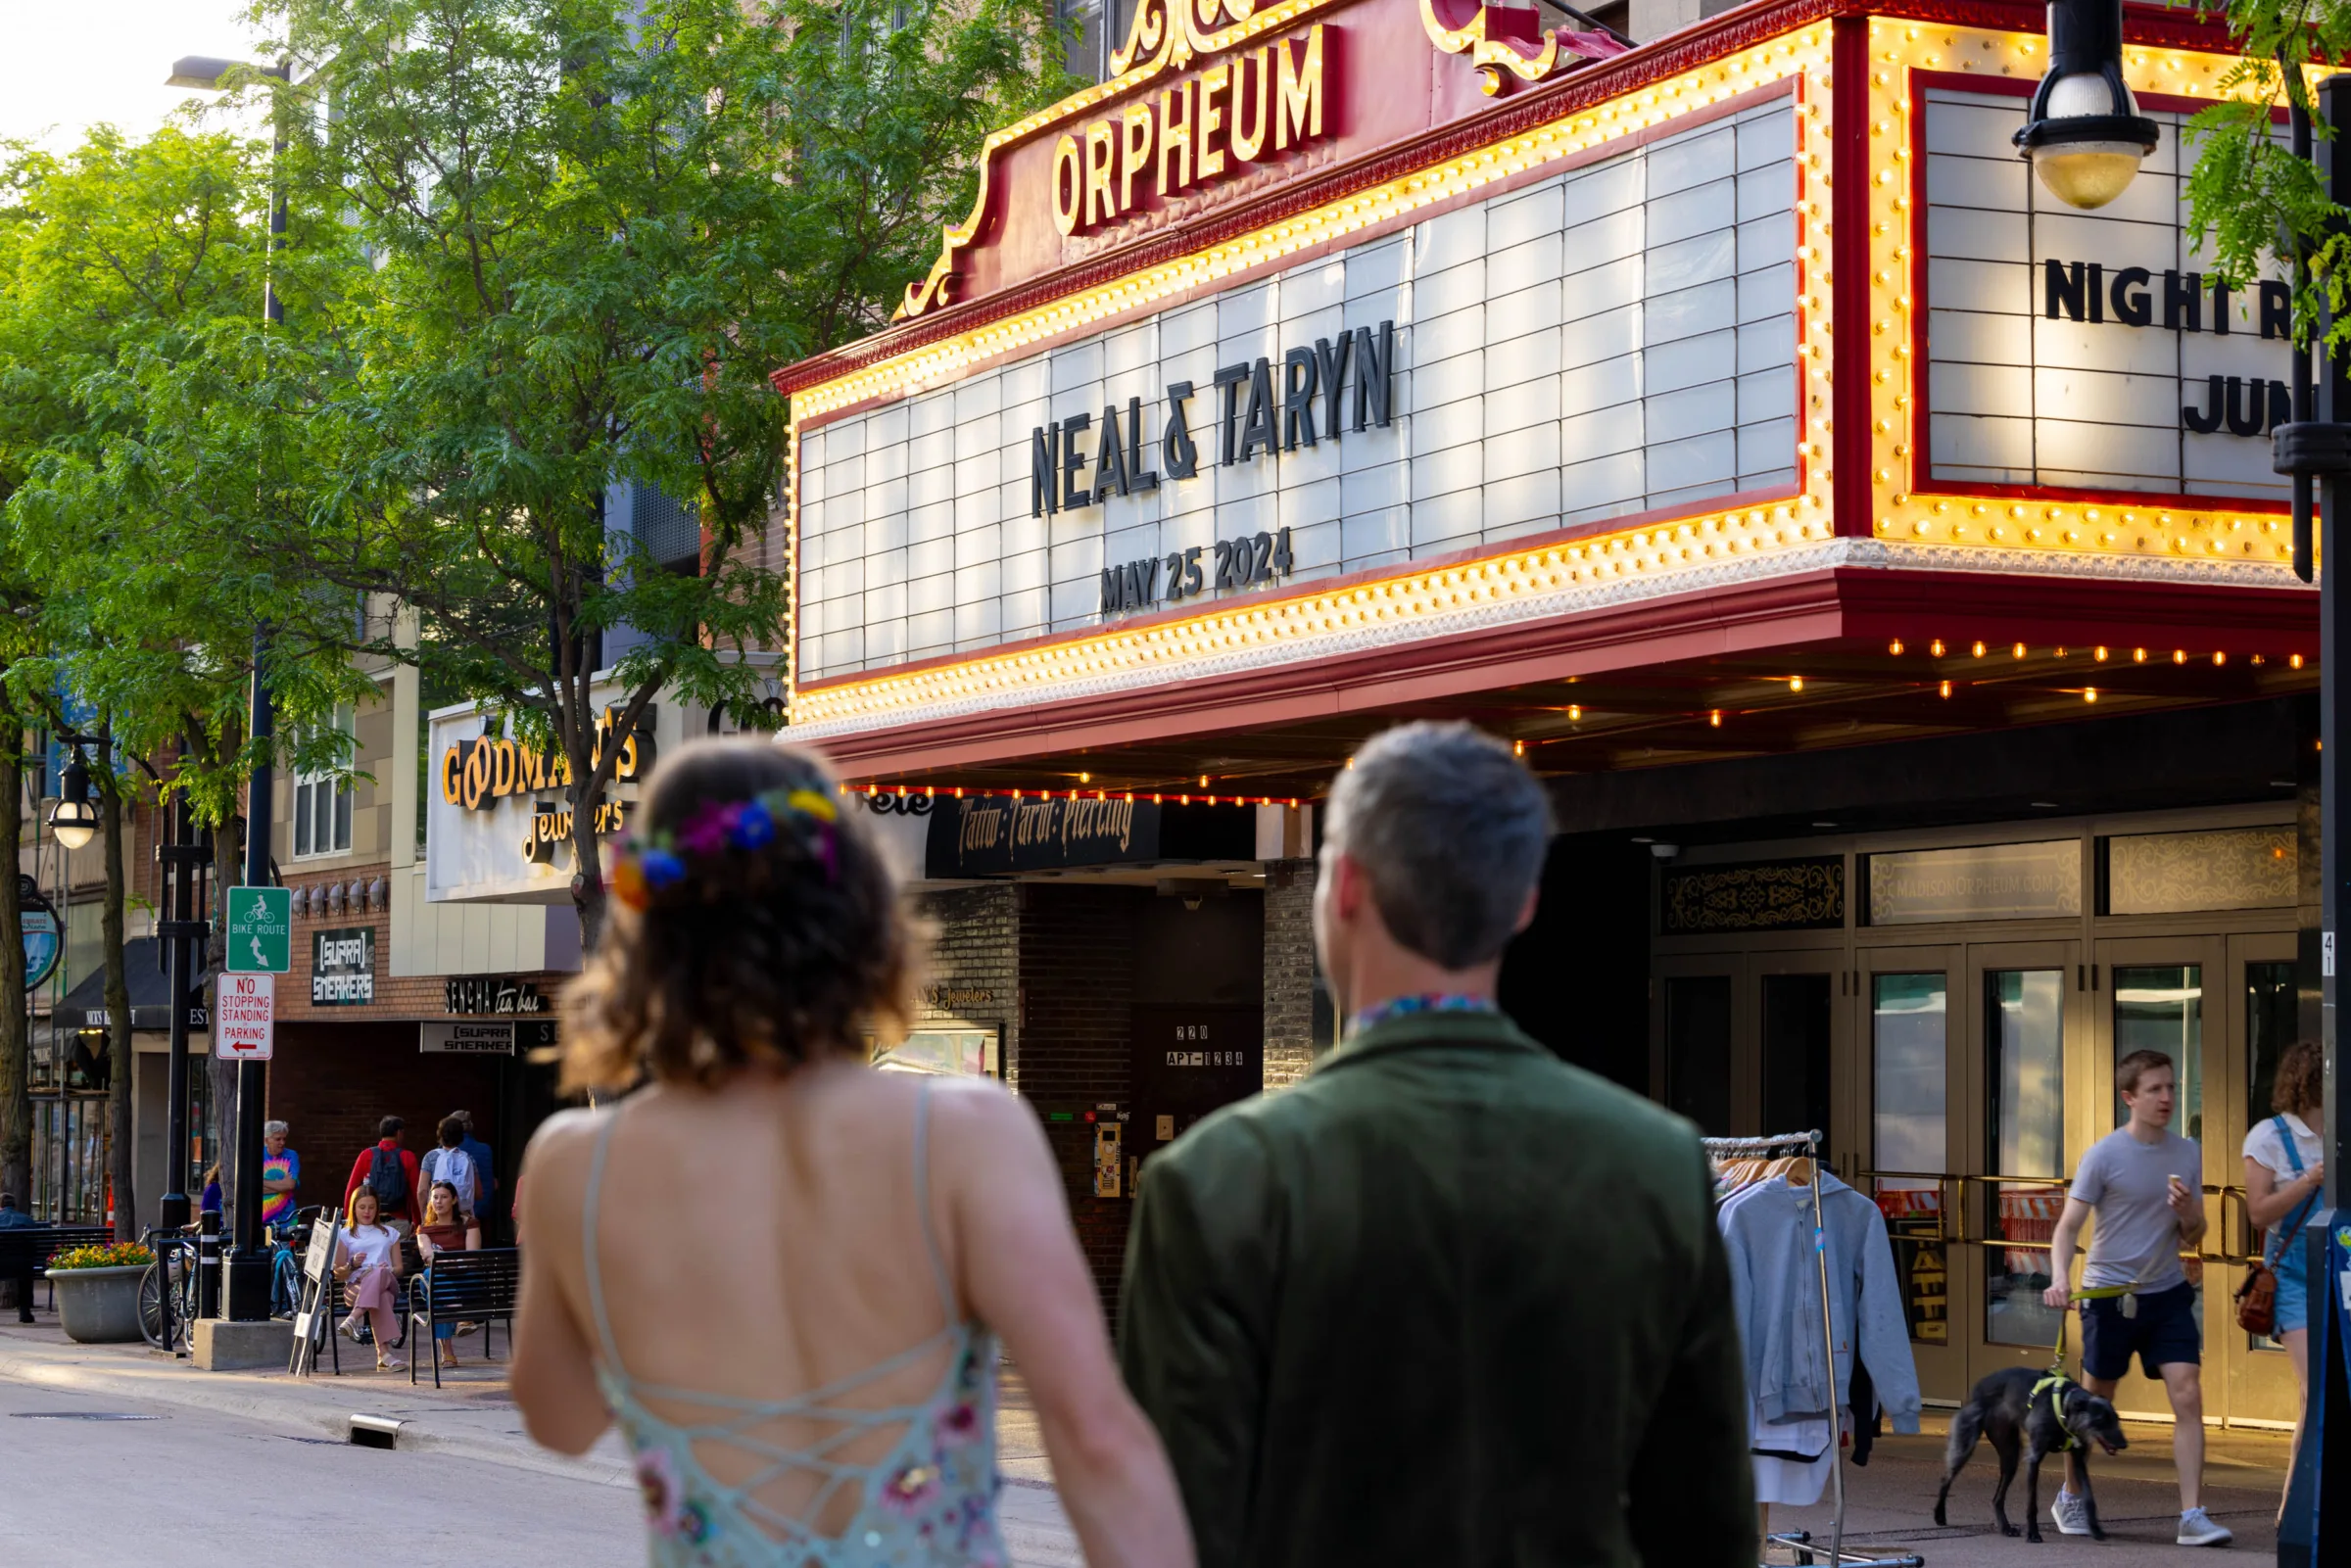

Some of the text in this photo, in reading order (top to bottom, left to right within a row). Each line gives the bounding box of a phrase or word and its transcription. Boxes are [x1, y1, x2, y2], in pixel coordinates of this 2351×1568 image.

[1052, 24, 1324, 235] ORPHEUM
[2044, 259, 2237, 336] NIGHT
[1032, 320, 1394, 518] NEAL & TARYN
[1101, 527, 1292, 613] MAY 25 2024
[232, 924, 286, 935] BIKE ROUTE
[236, 978, 256, 994] NO
[312, 974, 372, 1000] SNEAKERS
[445, 981, 539, 1014] SENCHA tea bar
[943, 985, 993, 1010] jewelers
[221, 995, 270, 1008] STOPPING
[221, 1009, 269, 1022] STANDING
[224, 1027, 265, 1040] PARKING
[1177, 1026, 1208, 1040] 220
